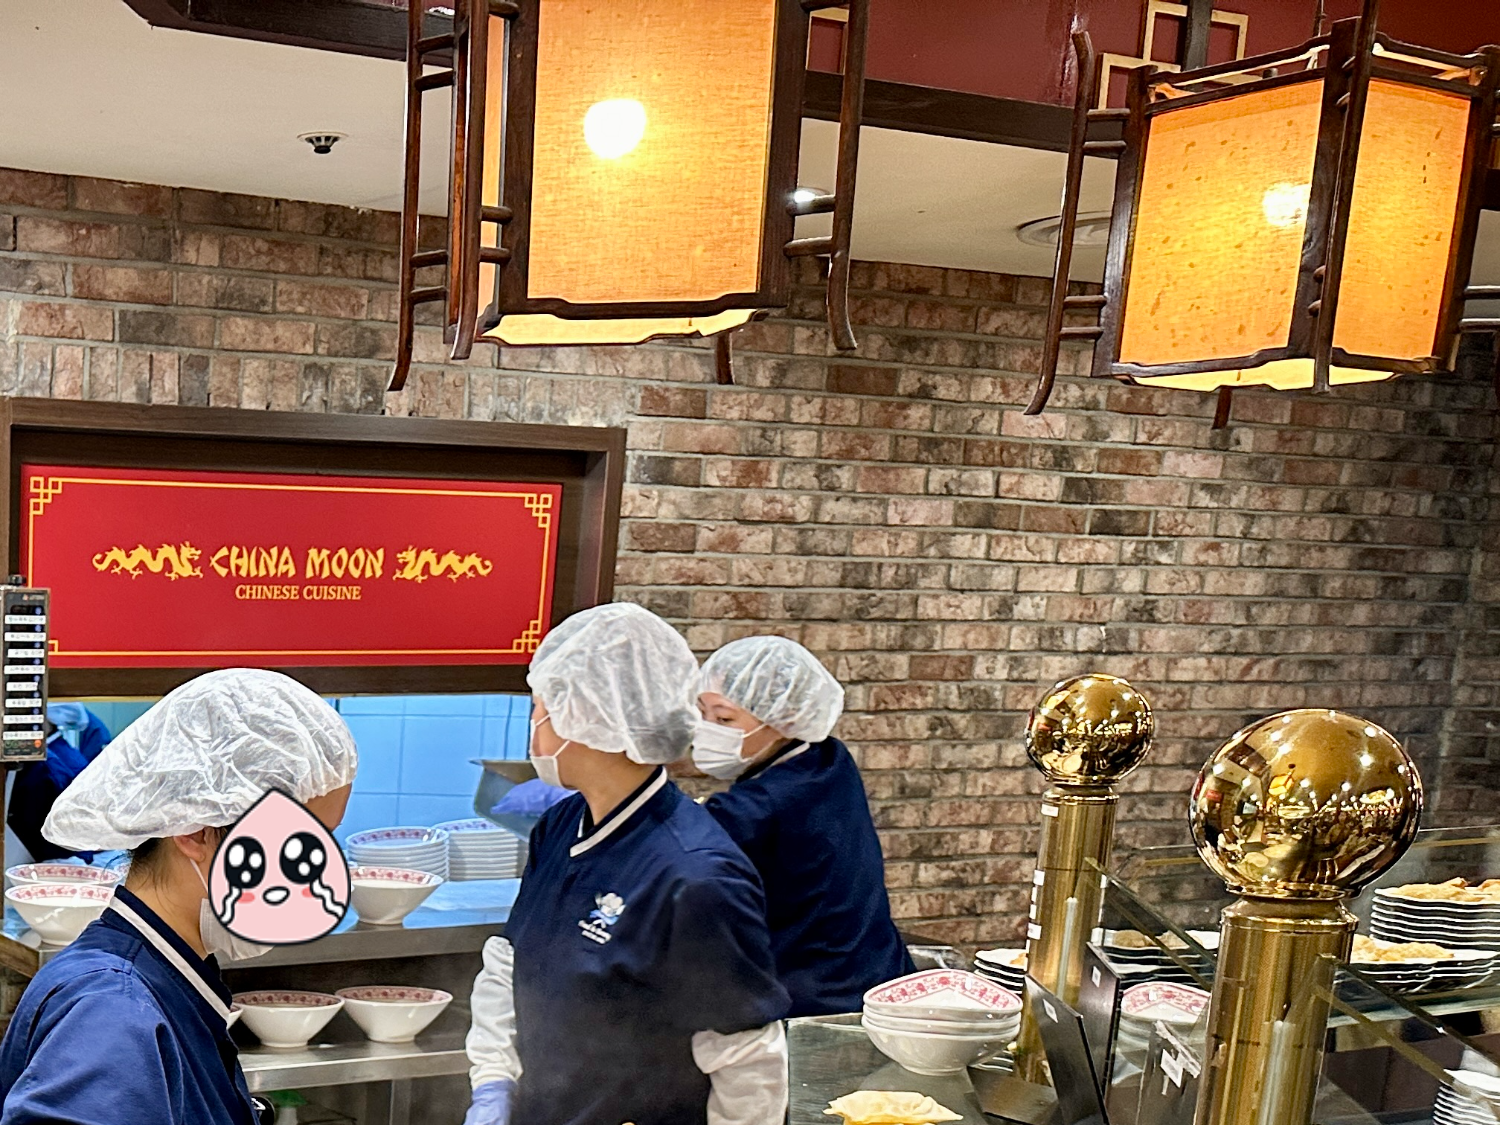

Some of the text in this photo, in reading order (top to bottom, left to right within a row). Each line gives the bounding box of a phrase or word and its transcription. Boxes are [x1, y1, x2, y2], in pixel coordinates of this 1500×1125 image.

[209, 545, 385, 579] CHINA MOON
[235, 584, 362, 600] CHINESE CUISINE
